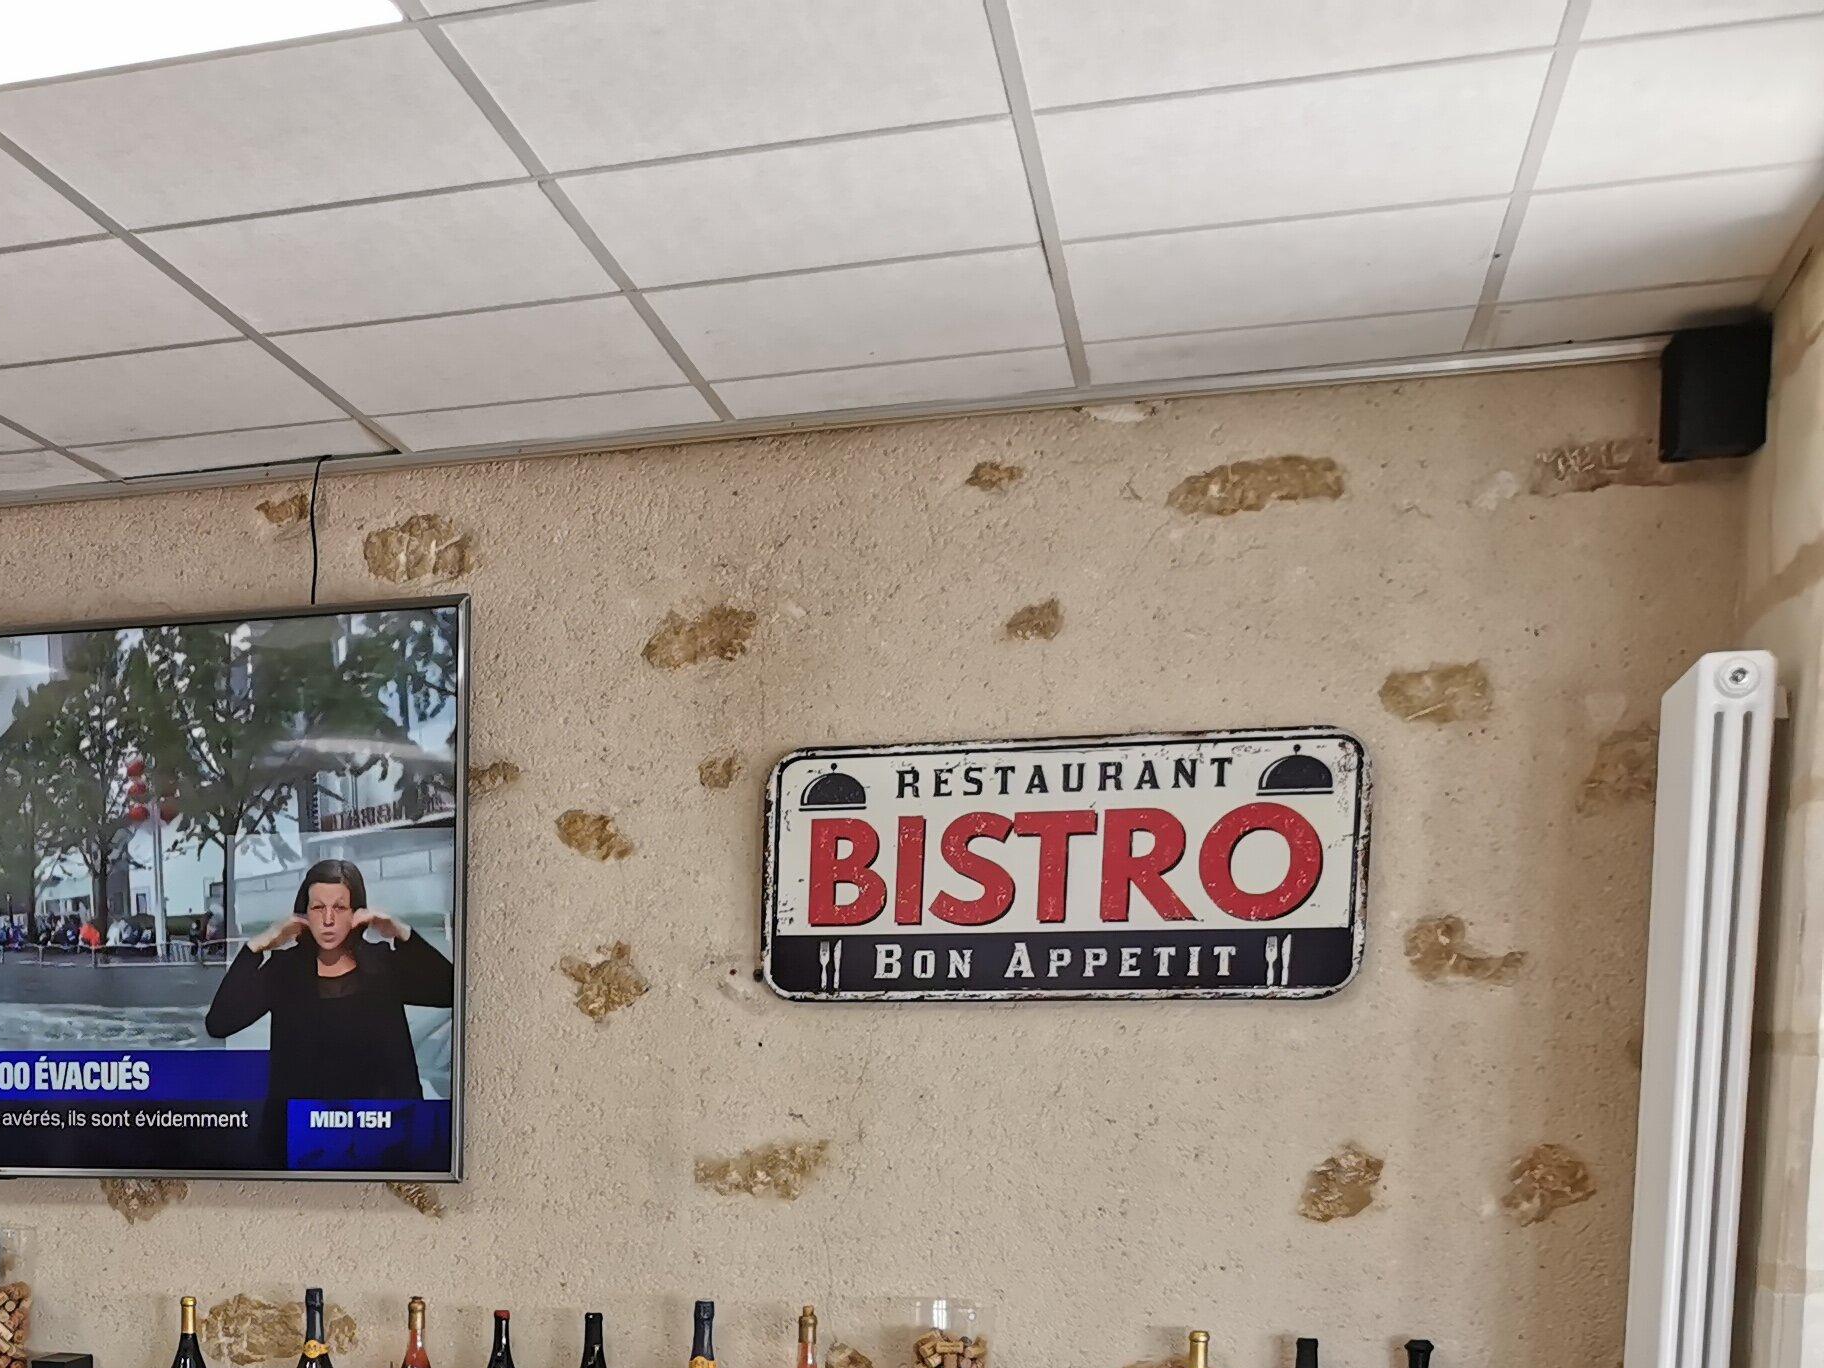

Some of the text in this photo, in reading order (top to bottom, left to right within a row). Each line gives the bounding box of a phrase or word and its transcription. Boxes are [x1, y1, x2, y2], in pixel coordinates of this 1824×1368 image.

[895, 756, 1234, 799] RESTAURANT
[807, 801, 1325, 928] BISTRO
[34, 1055, 150, 1091] ÉVACUÉS
[2, 1109, 65, 1129] avérés,
[68, 1108, 87, 1127] ils
[91, 1109, 130, 1127] sont
[135, 1109, 249, 1128] évidemment
[309, 1110, 392, 1129] MIDI 15H
